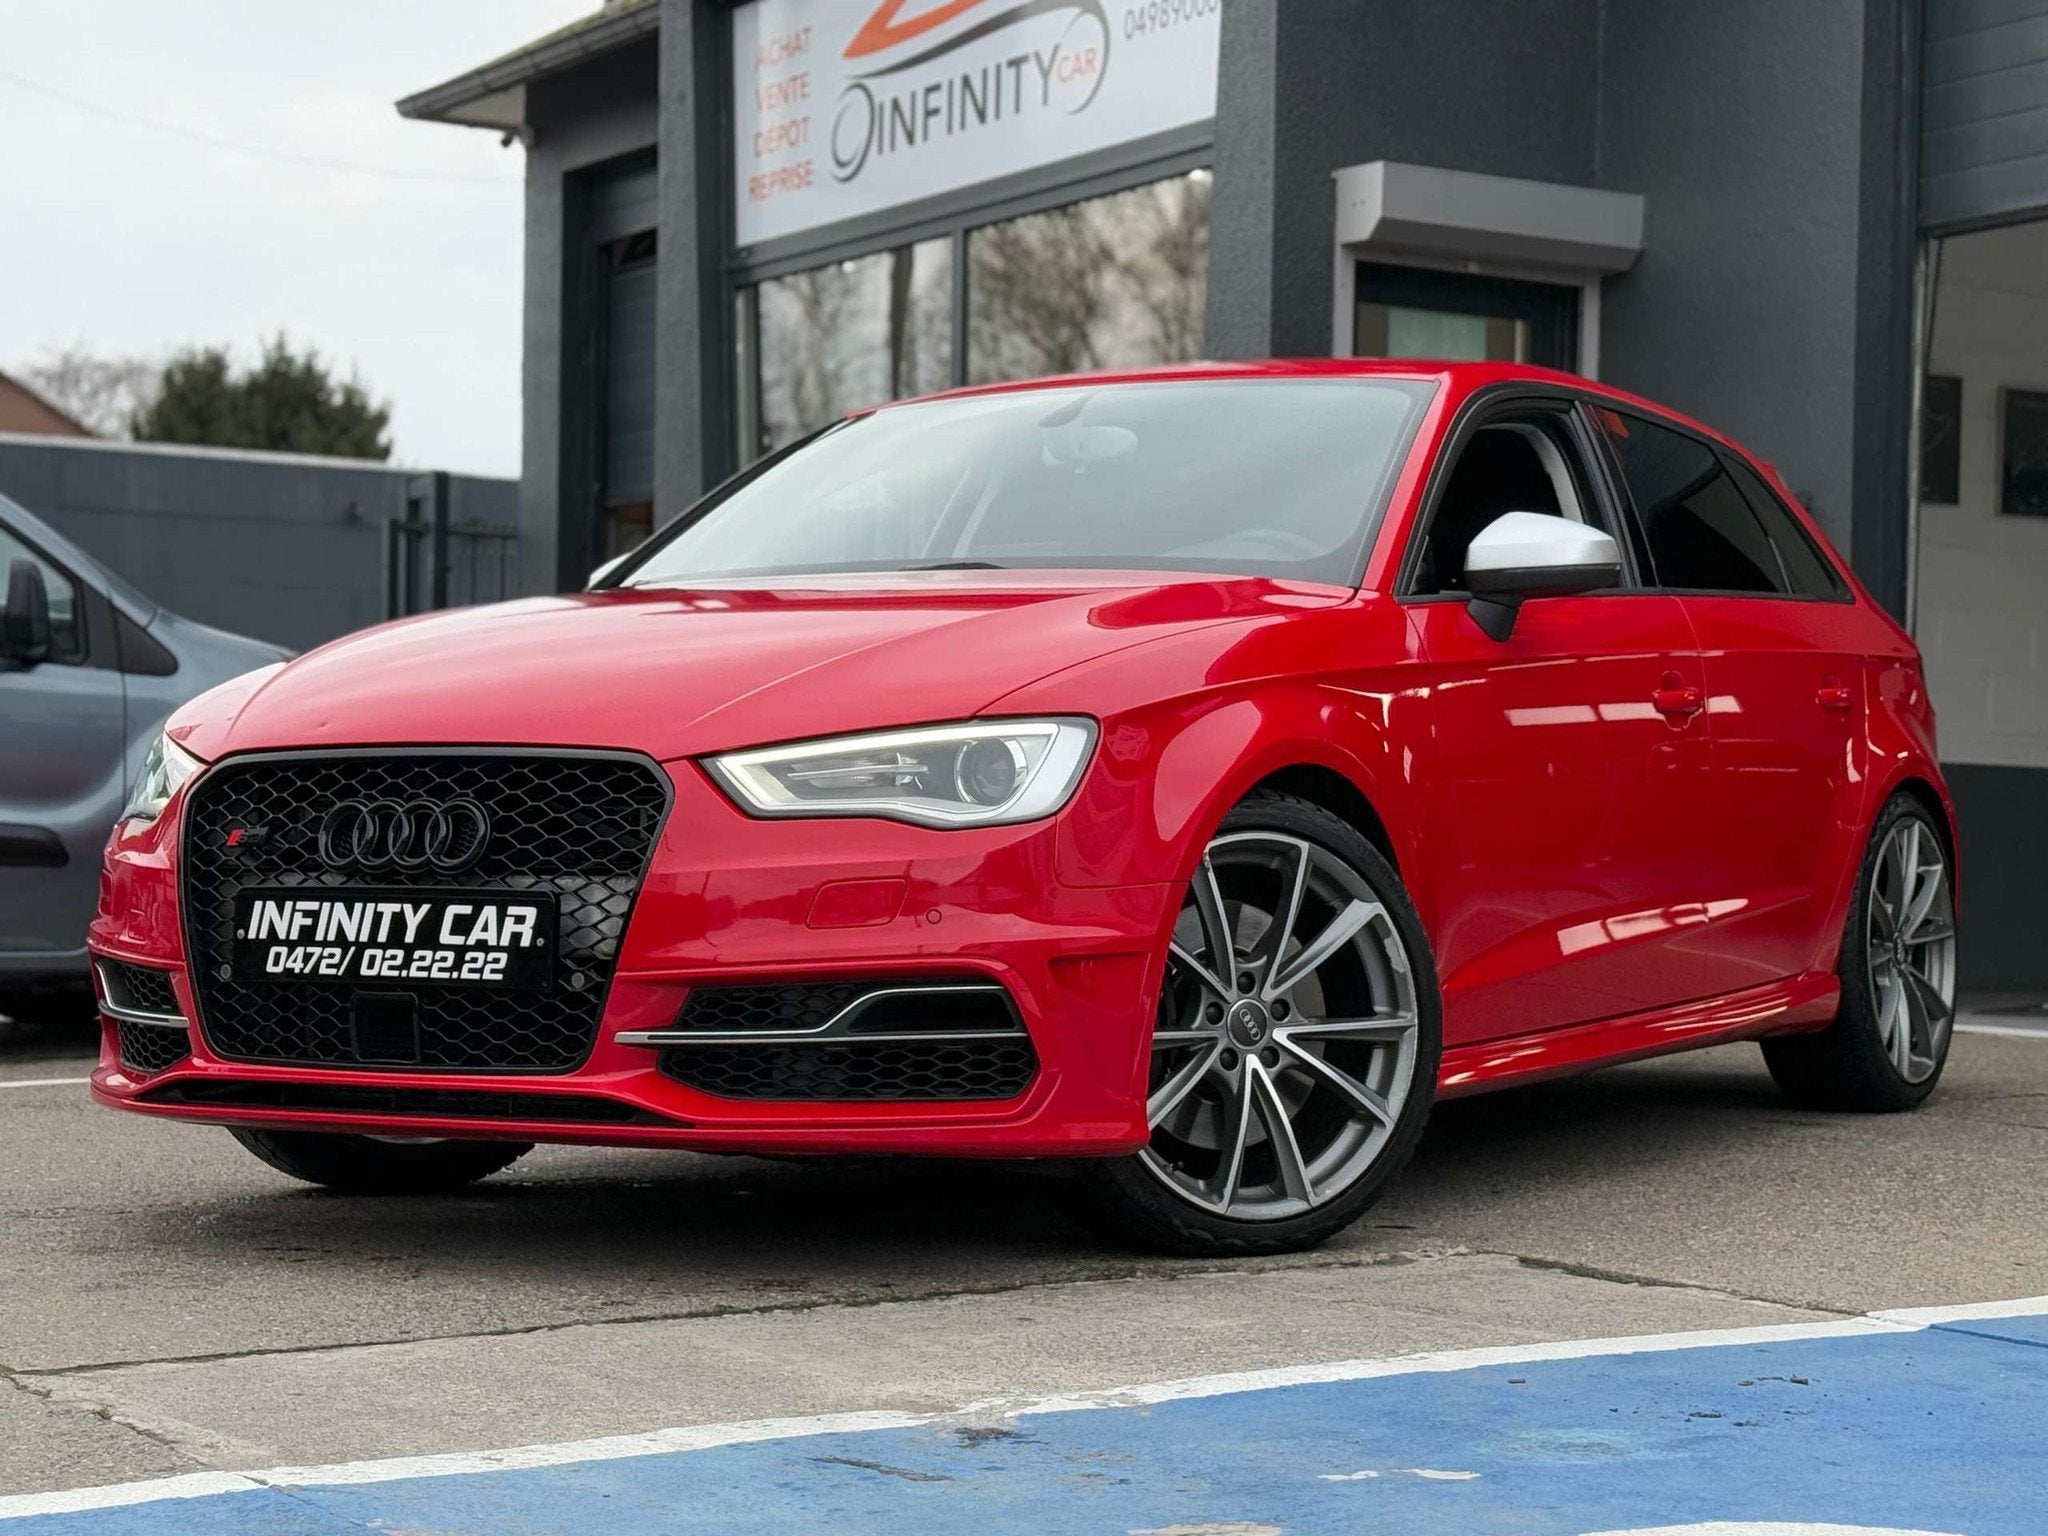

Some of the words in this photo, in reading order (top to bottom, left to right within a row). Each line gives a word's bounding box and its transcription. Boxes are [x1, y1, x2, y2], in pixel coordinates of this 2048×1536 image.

[876, 44, 1060, 156] INFINITY
[1056, 48, 1096, 83] CAR
[749, 160, 813, 200] REPRISE
[248, 900, 431, 943] INFINITY
[439, 905, 537, 947] CAR
[265, 946, 355, 975] 0472/
[360, 948, 508, 980] 02.22.22
